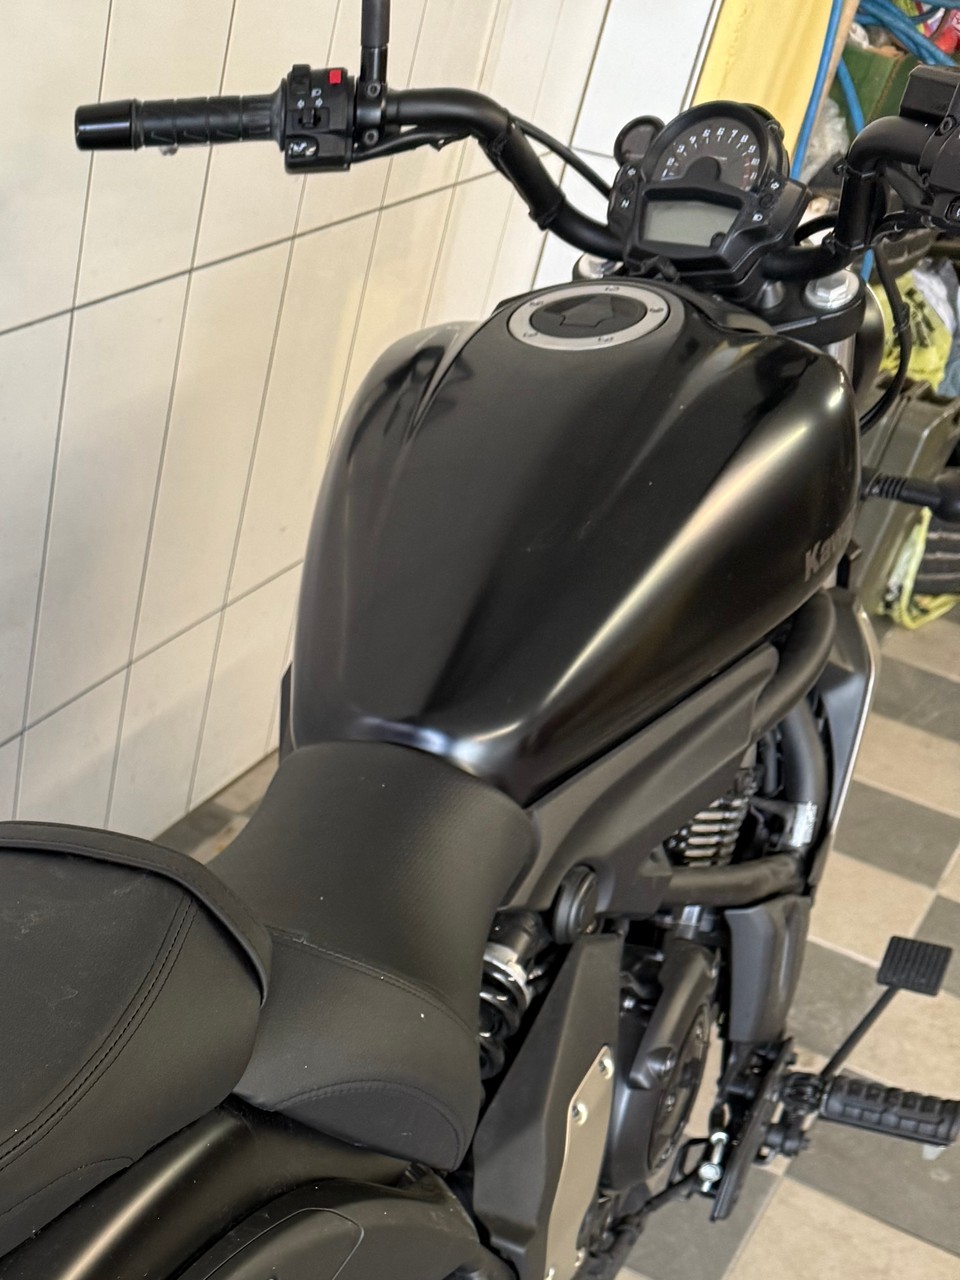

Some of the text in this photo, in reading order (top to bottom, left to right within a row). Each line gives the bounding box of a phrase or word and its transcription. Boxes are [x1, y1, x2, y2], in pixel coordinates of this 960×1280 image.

[689, 135, 697, 144] 4
[732, 129, 739, 137] 7
[748, 144, 757, 153] 9
